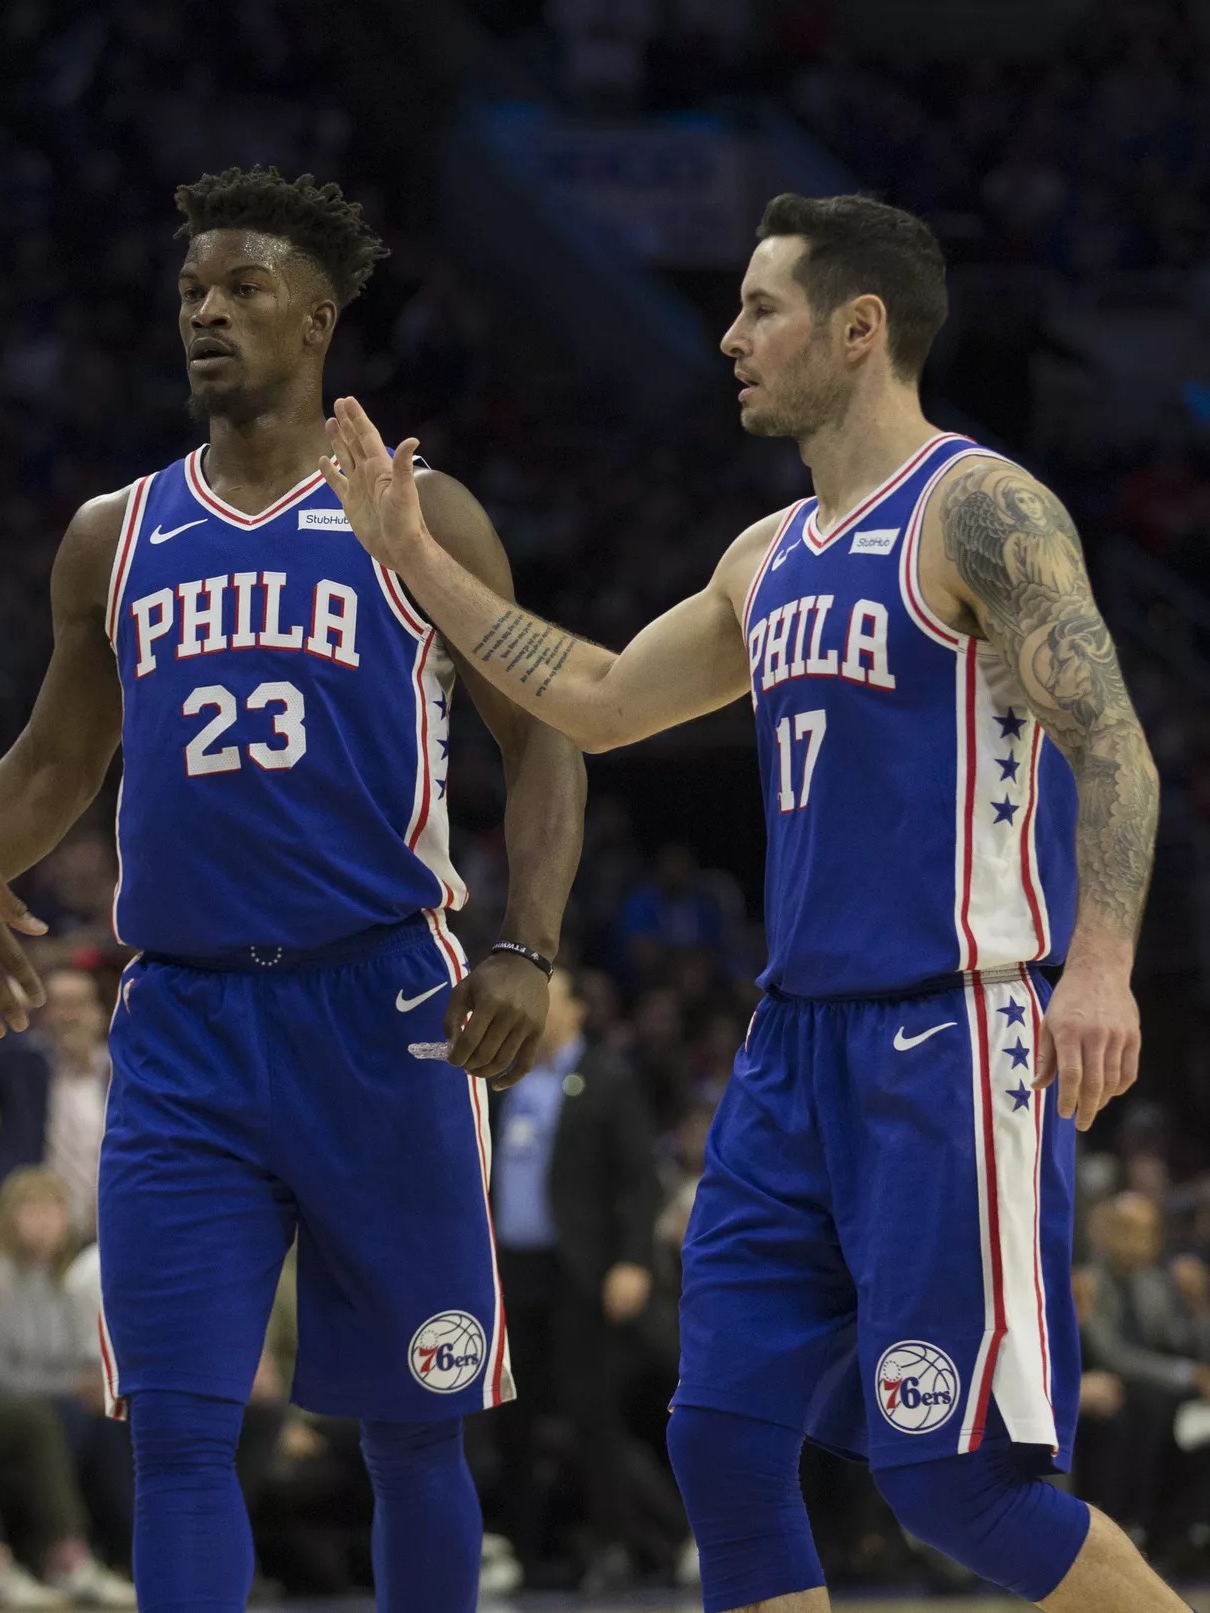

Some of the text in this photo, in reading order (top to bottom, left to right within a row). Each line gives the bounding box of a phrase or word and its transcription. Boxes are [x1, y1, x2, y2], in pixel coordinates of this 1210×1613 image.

[131, 571, 360, 679] PHILA
[749, 595, 896, 714] PHILA
[183, 681, 307, 777] 23
[776, 709, 827, 813] 17
[418, 1343, 479, 1373] 76ers
[882, 1376, 951, 1410] 76ers
